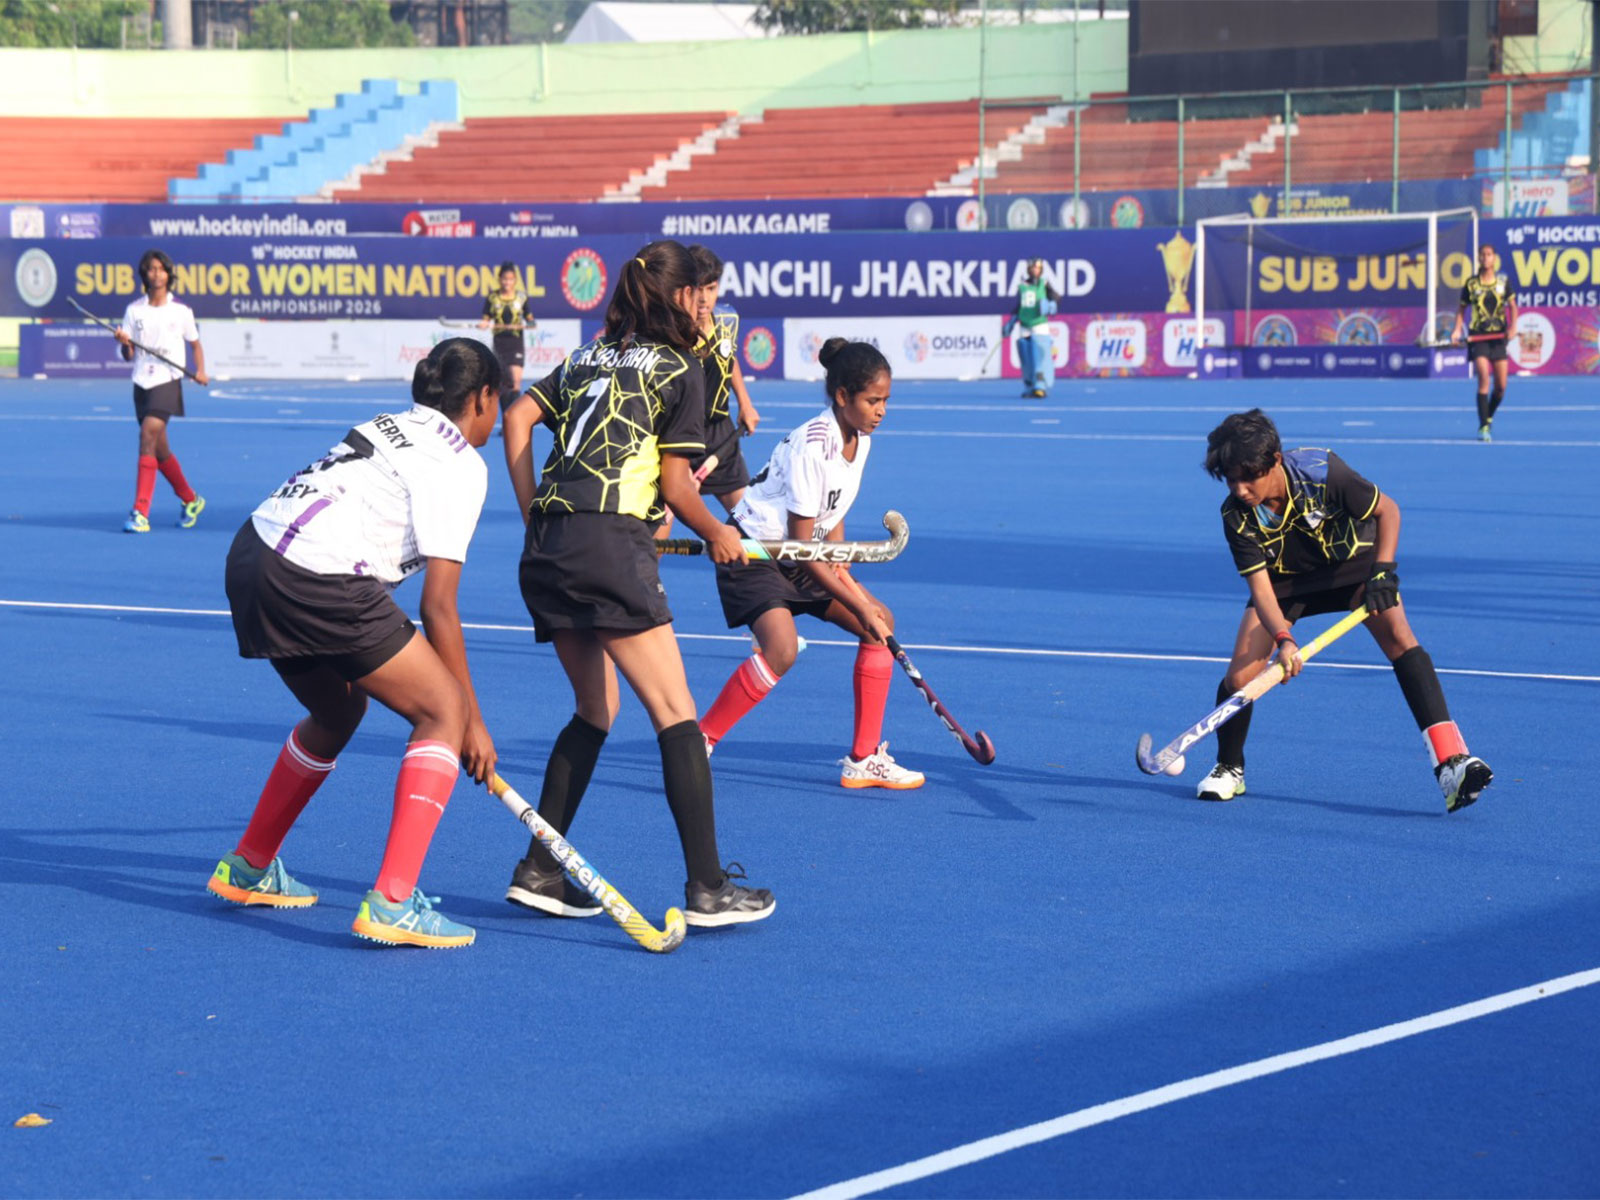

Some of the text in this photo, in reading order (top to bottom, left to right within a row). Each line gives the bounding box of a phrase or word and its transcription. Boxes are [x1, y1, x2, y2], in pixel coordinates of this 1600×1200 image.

[661, 213, 831, 236] #INDIAKAGAME
[273, 245, 322, 260] HOCKEY
[323, 245, 358, 260] INDIA
[75, 263, 136, 295] SUB
[256, 263, 377, 296] WOMEN
[717, 259, 843, 304] ANCHI,
[1258, 255, 1339, 293] SUB
[231, 299, 382, 315] CHAMPIONSHIP 2026
[932, 335, 987, 350] ODISHA
[564, 377, 612, 457] 7
[1179, 704, 1241, 753] ALFA
